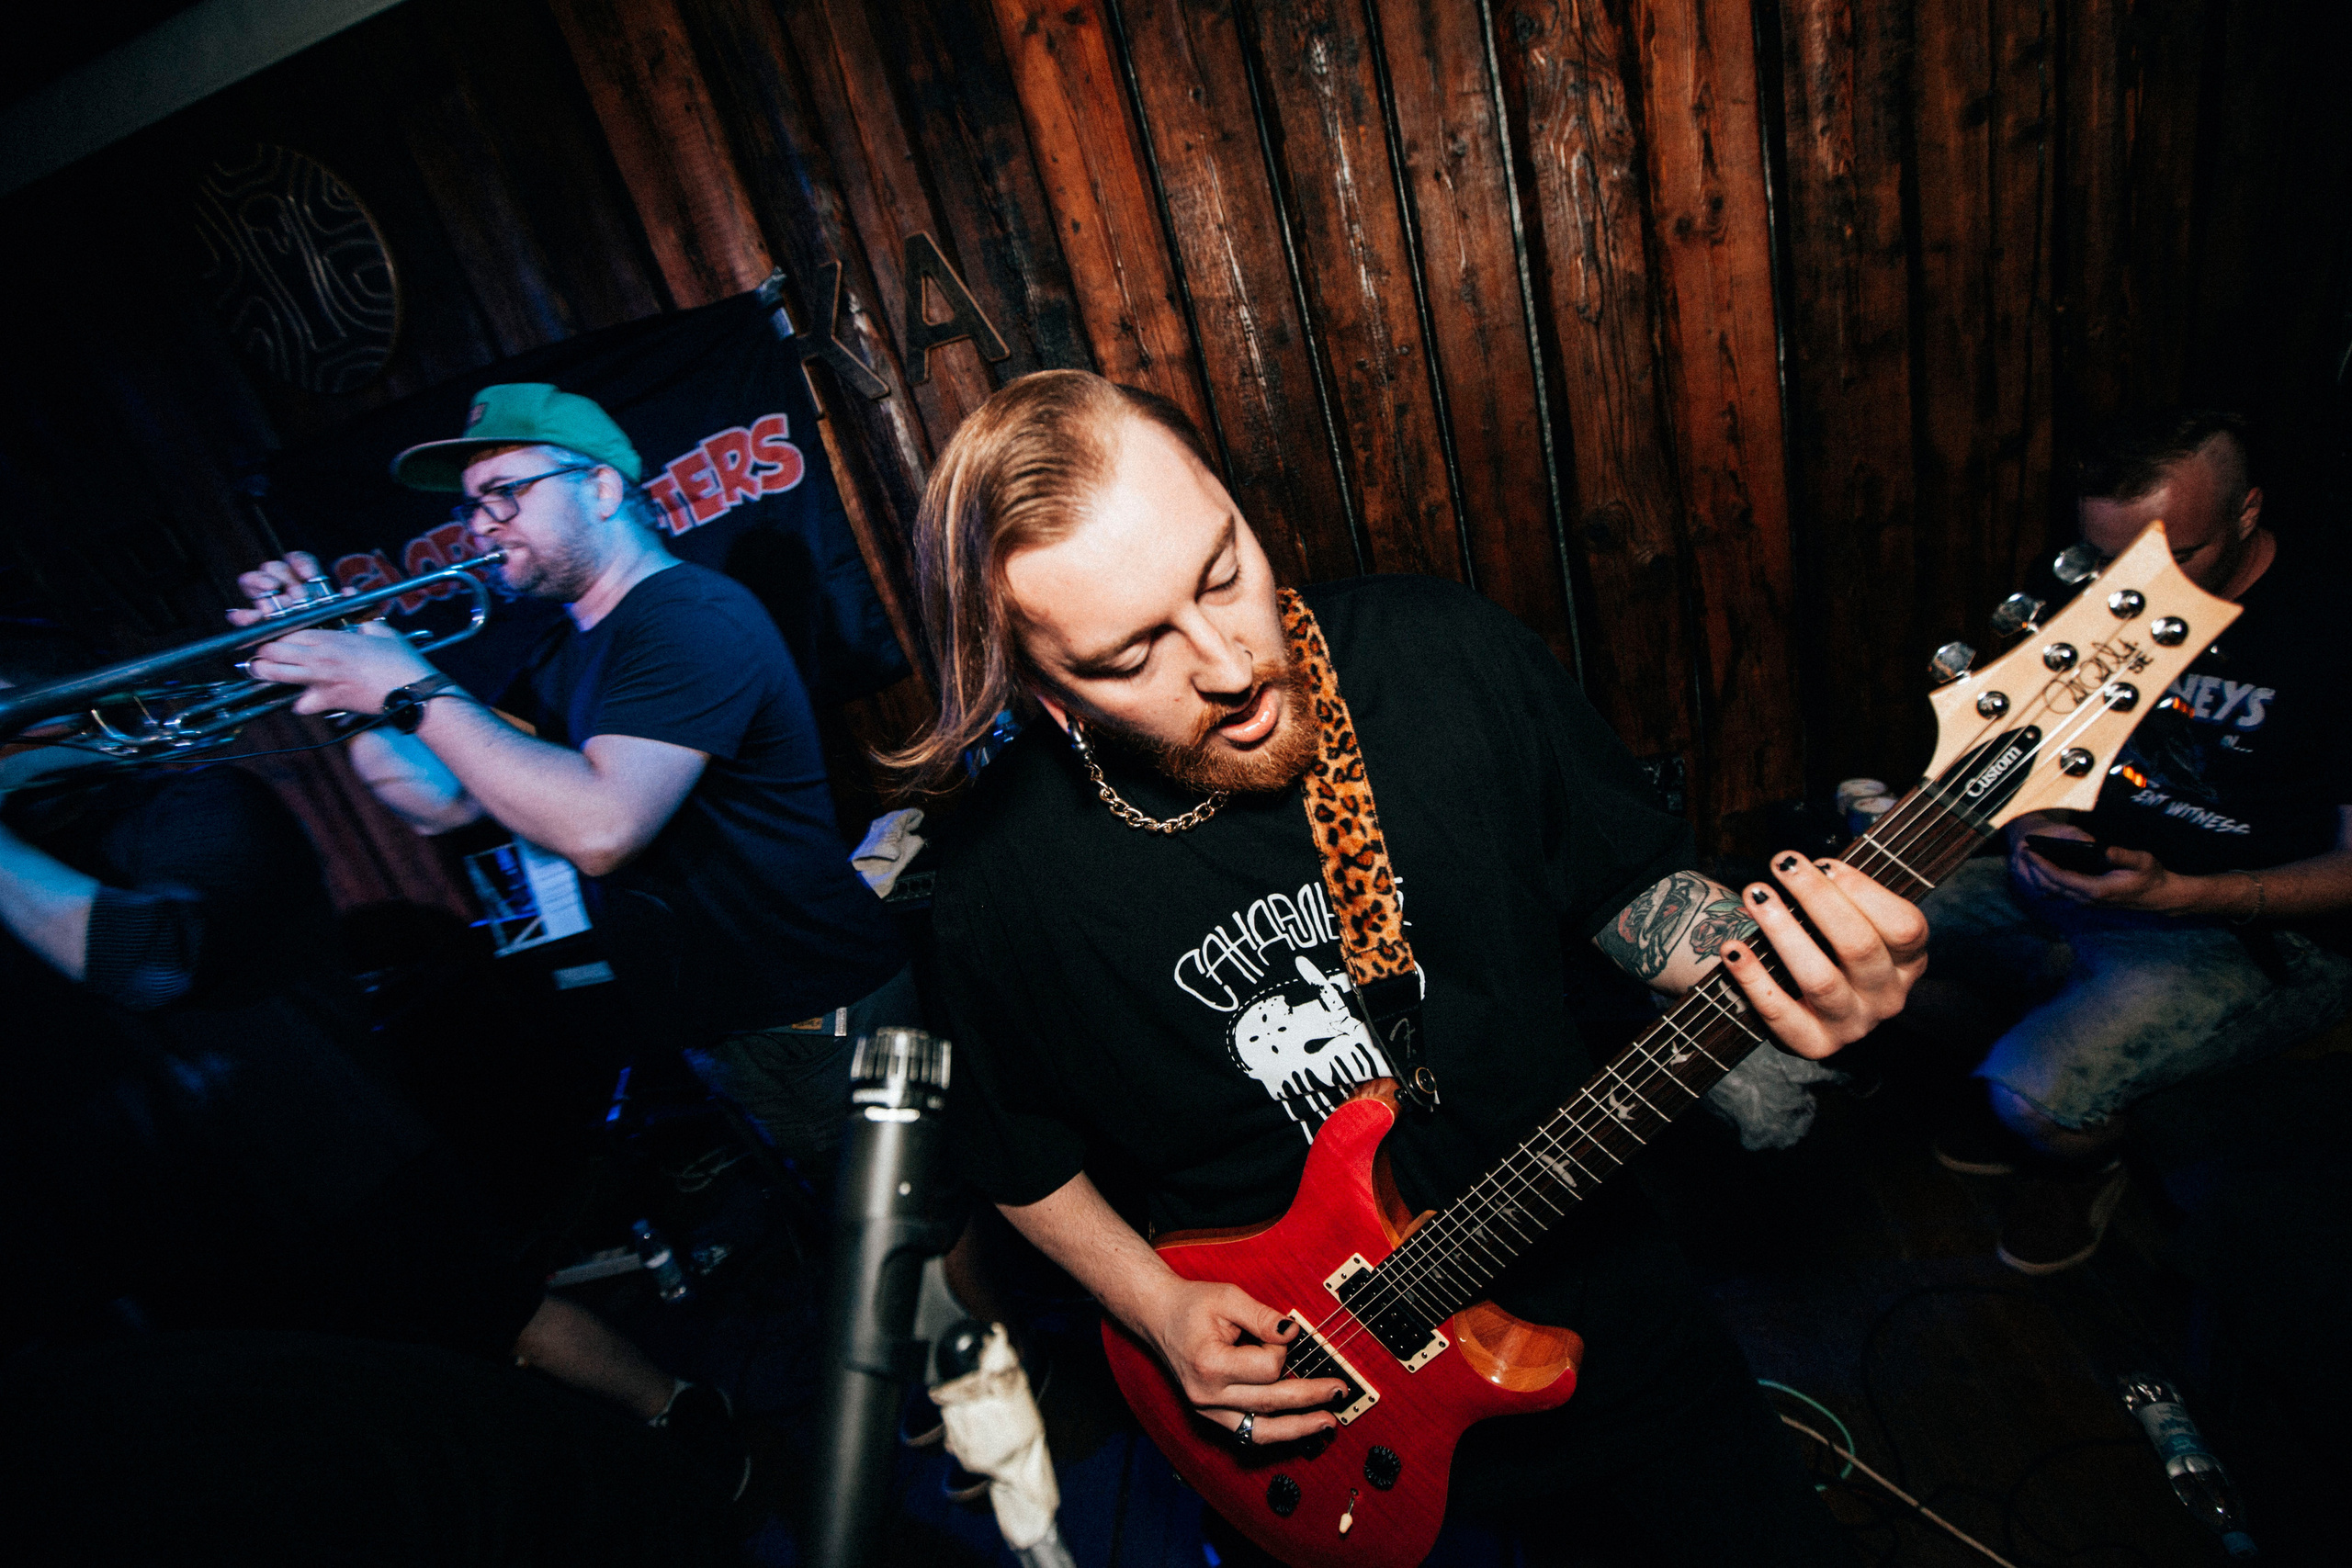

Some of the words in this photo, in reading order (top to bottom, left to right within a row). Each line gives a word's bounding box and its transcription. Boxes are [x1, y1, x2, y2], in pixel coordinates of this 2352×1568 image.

[641, 412, 805, 537] TERS
[2167, 672, 2277, 732] NEYS
[1964, 745, 2024, 798] Custom
